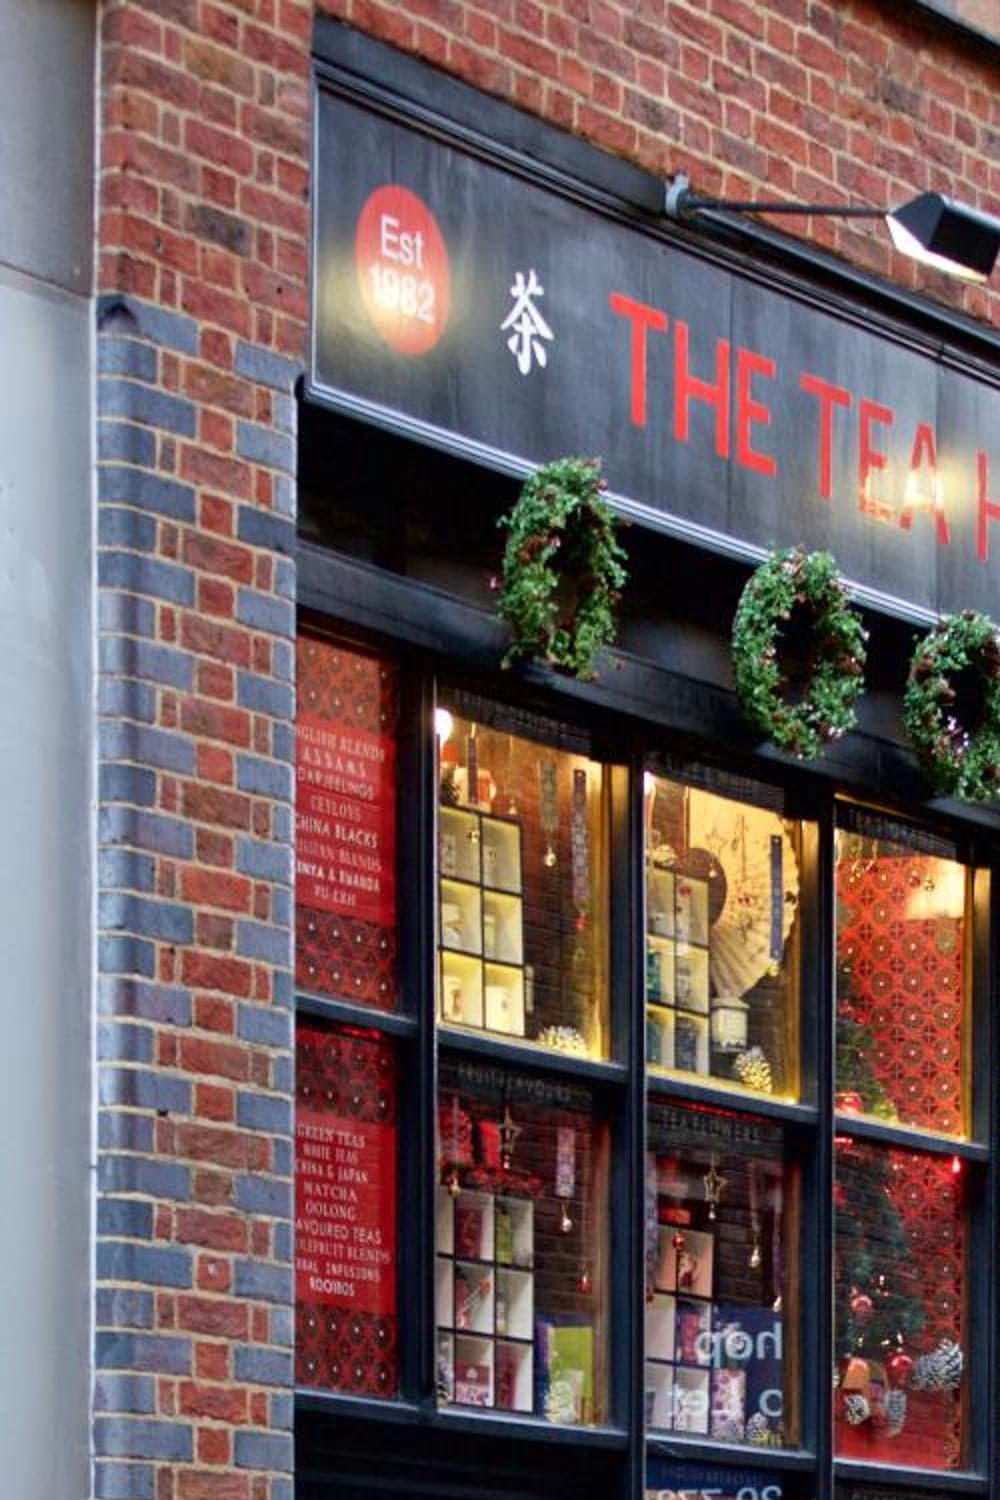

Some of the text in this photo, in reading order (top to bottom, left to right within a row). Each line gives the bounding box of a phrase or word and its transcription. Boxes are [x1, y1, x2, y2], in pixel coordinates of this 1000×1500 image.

[380, 215, 426, 267] Est
[368, 264, 437, 324] 1982
[501, 268, 555, 376] 茶
[609, 290, 778, 480] THE
[799, 373, 951, 546] TEA
[335, 823, 378, 849] BLACKS
[337, 1130, 366, 1149] TEAS
[303, 1181, 358, 1202] MATCHA
[305, 1200, 357, 1222] OOLONG
[352, 1227, 382, 1245] TEAS
